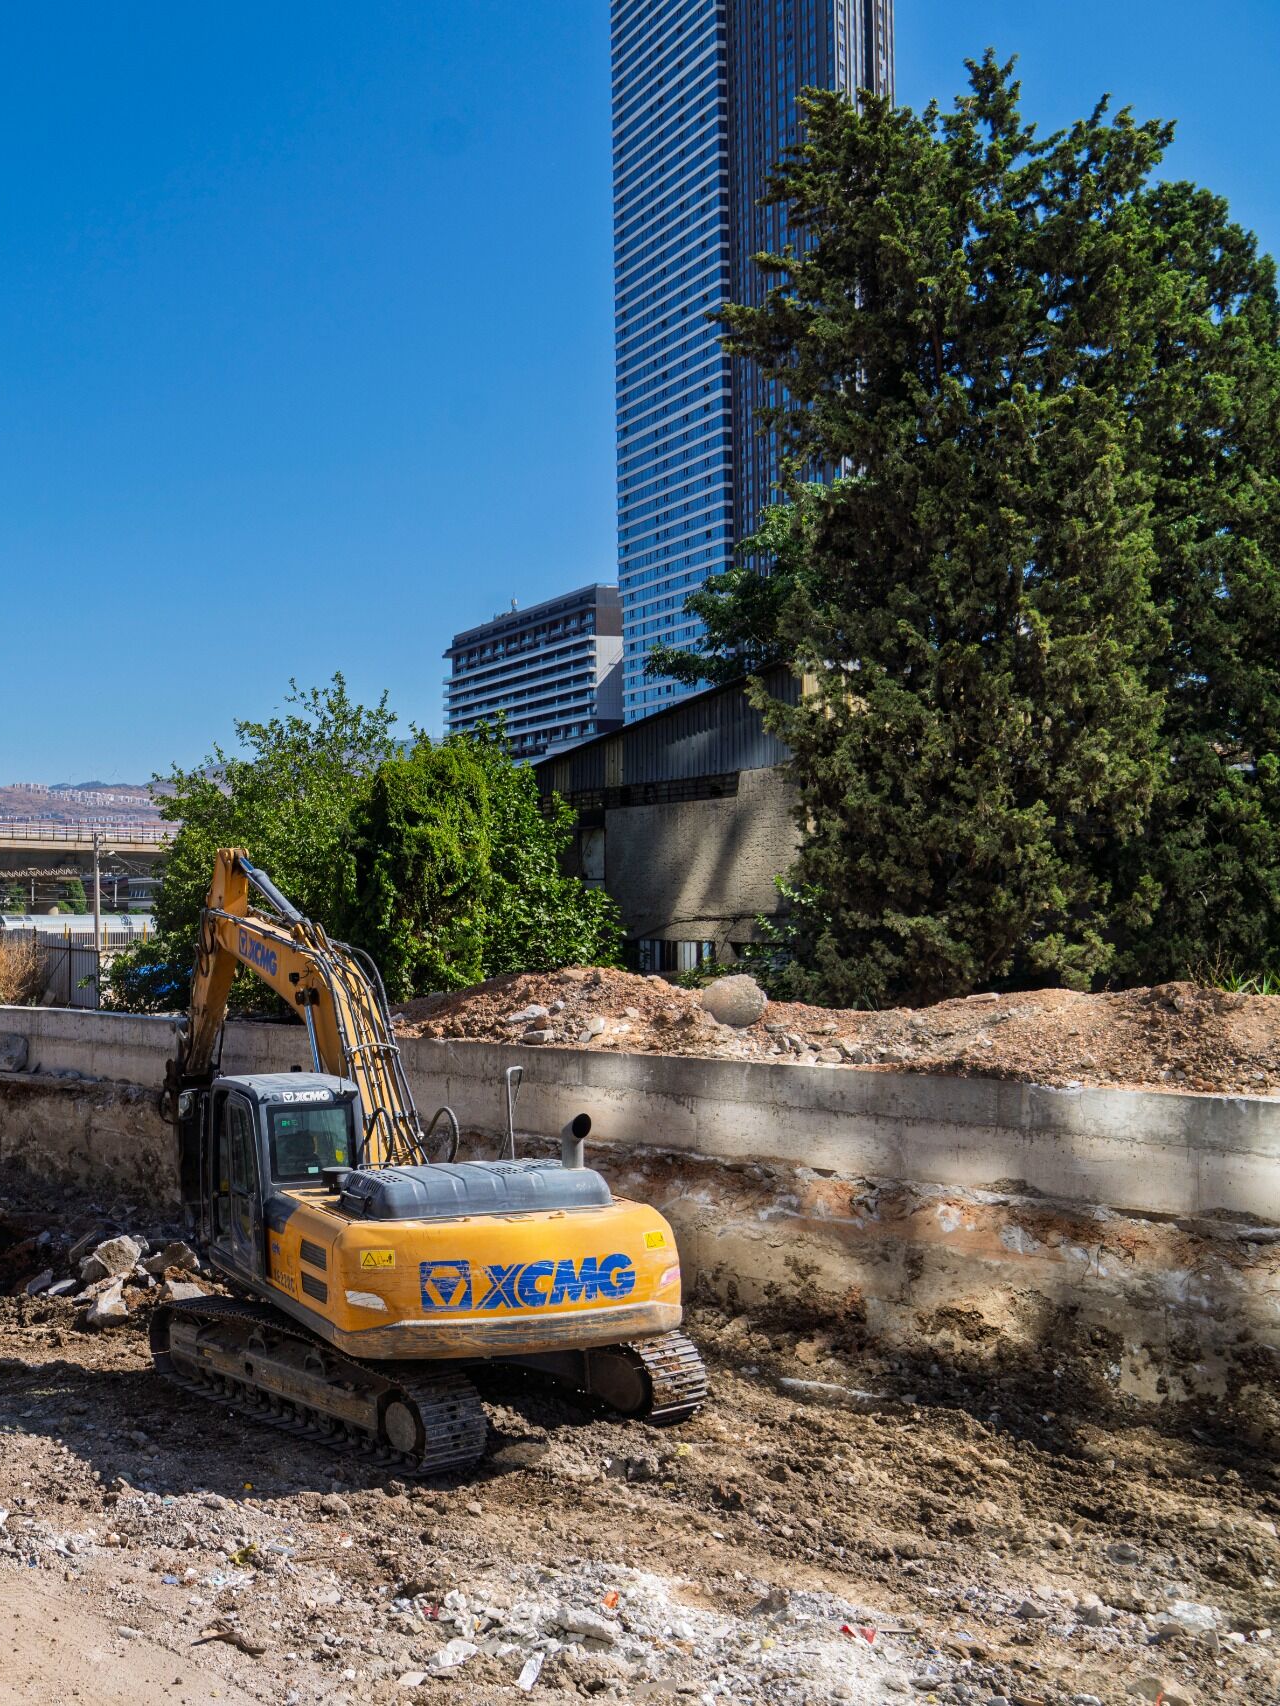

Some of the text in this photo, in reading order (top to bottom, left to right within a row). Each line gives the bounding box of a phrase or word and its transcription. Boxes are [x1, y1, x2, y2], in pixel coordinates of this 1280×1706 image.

[249, 936, 277, 977] XCMG
[294, 1090, 330, 1102] XCMG
[475, 1253, 636, 1310] XCMG
